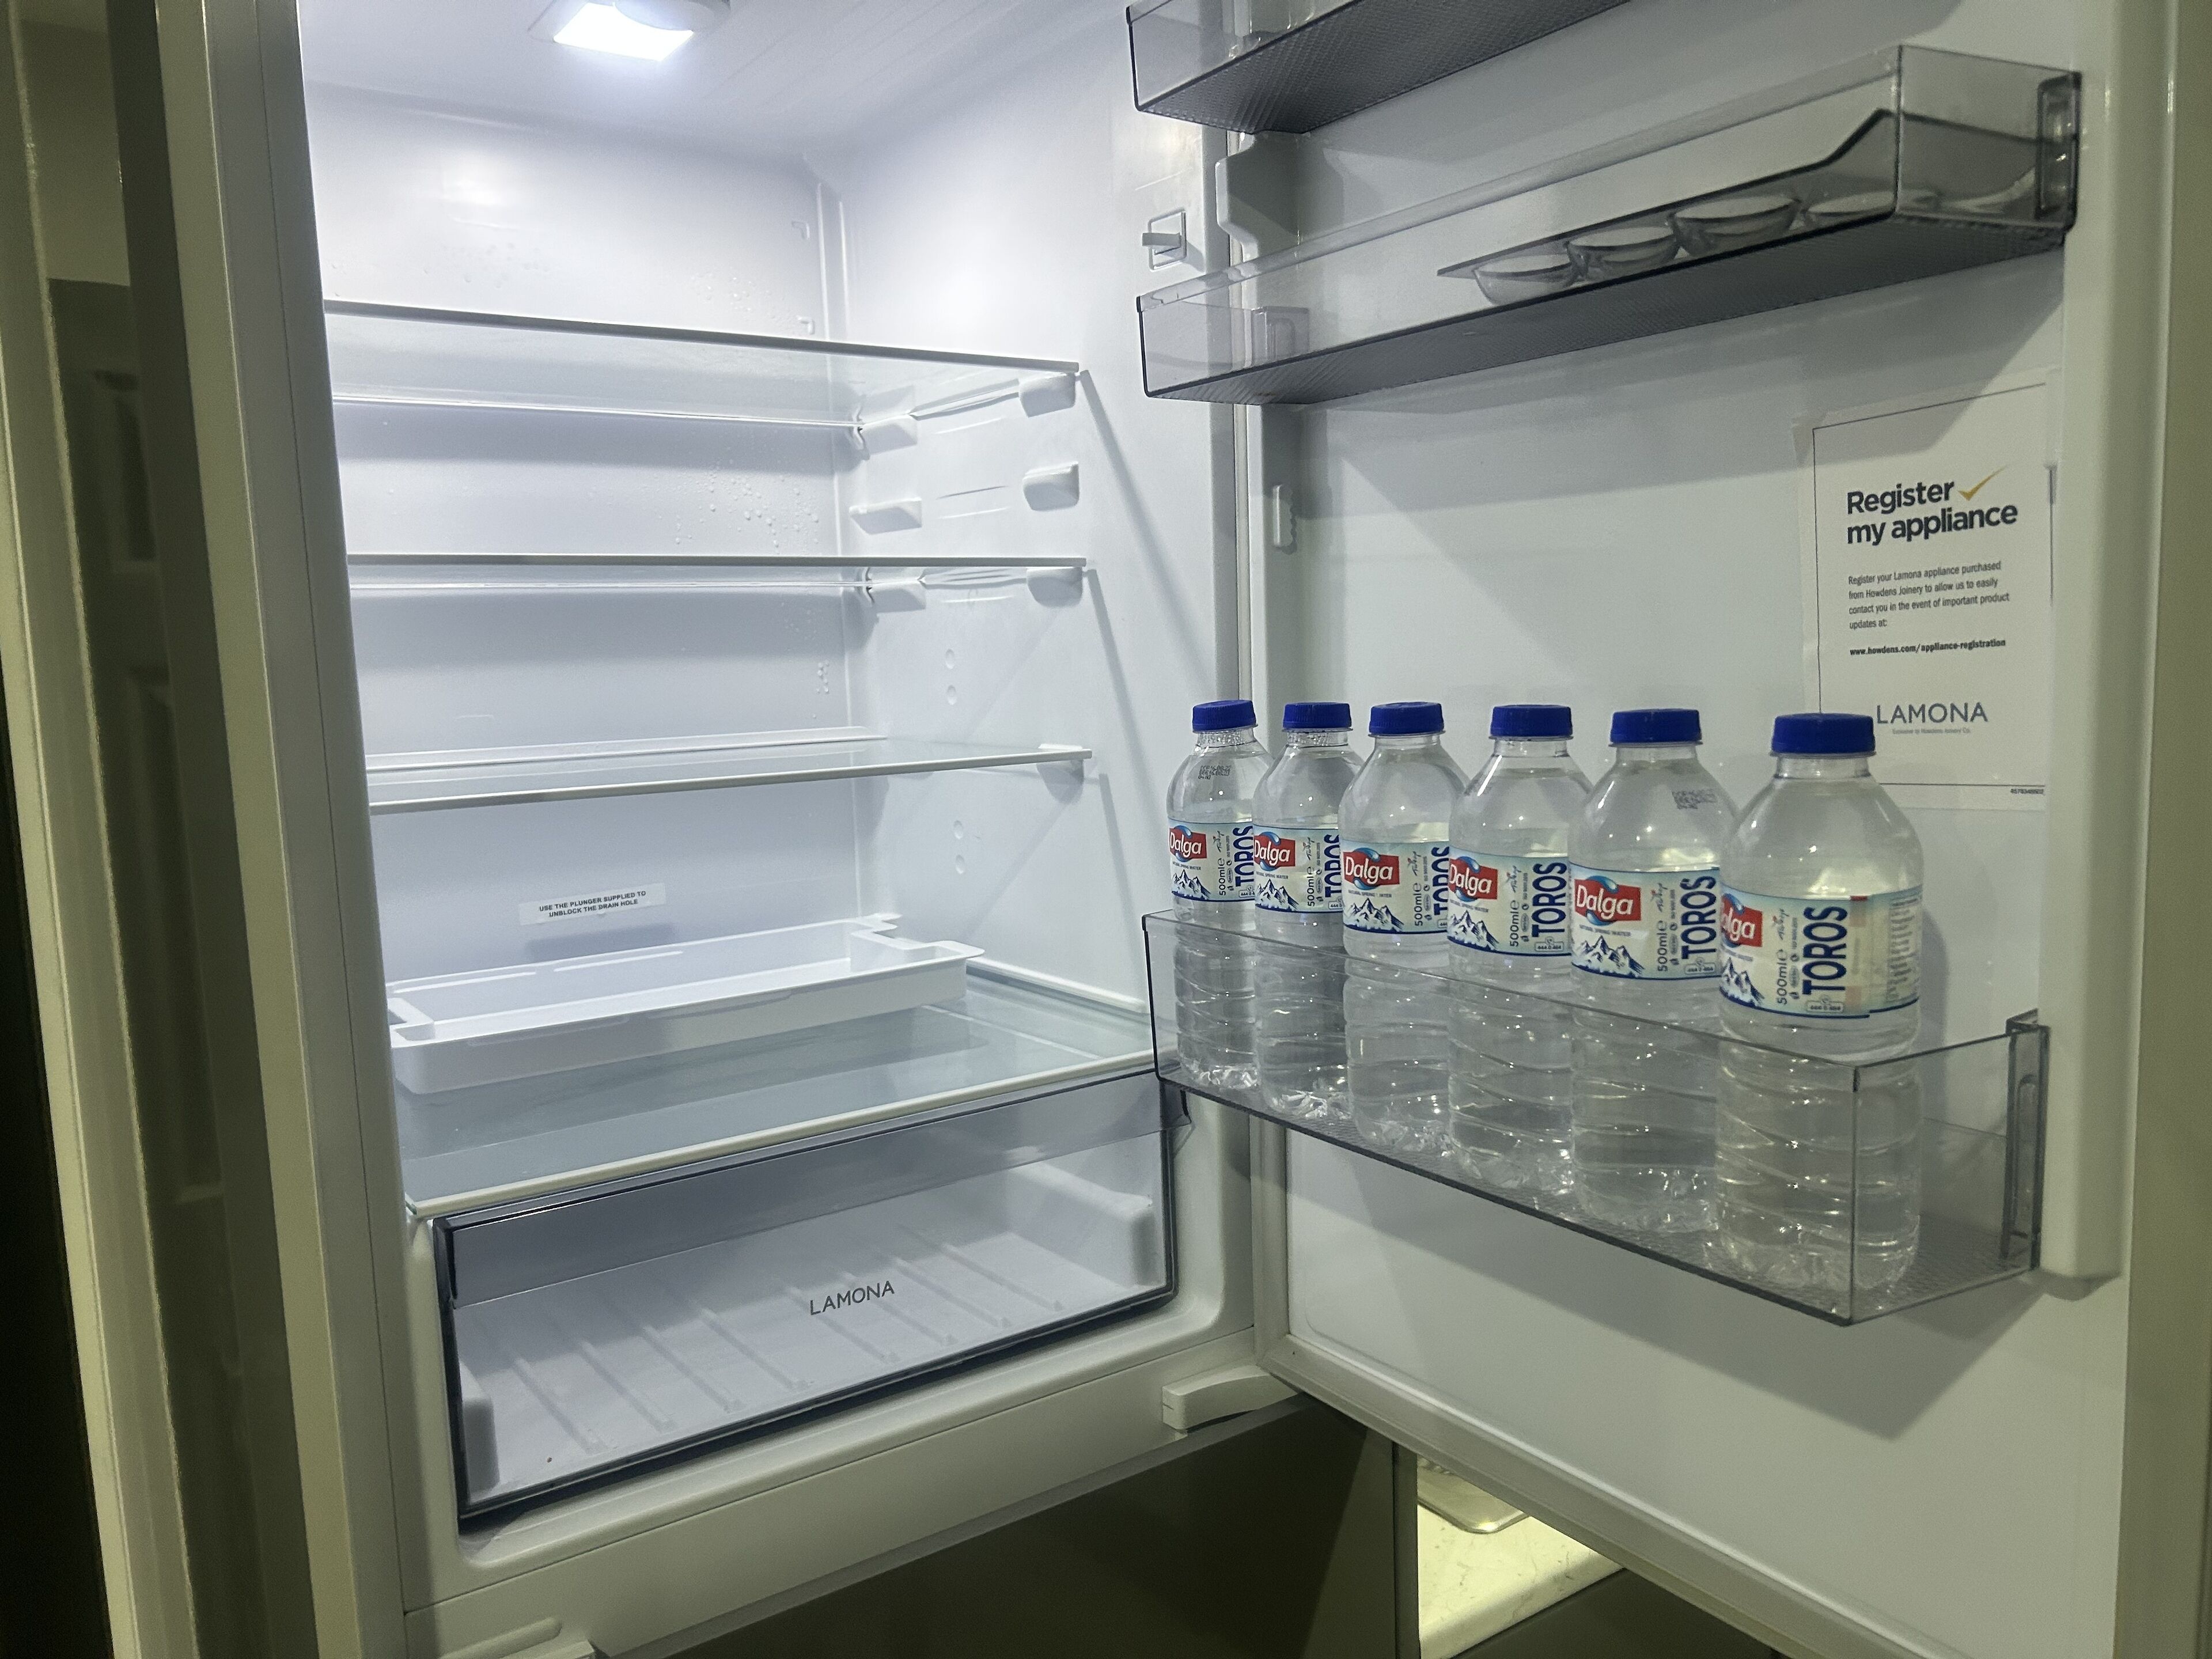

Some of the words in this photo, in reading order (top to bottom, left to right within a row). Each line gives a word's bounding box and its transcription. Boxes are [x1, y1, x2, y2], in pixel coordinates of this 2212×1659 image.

[1847, 479, 1955, 514] Register
[1847, 520, 1885, 546] my
[1891, 505, 2018, 542] appliance
[1849, 575, 1875, 586] Register
[1877, 573, 1892, 584] your
[1894, 571, 1922, 581] Lamona
[1924, 566, 1960, 578] appliance
[1962, 561, 2001, 575] purchased
[1849, 590, 1863, 599] from
[1866, 588, 1896, 598] Howdens
[1899, 585, 1923, 596] Joinery
[1934, 582, 1953, 592] allow
[1966, 581, 1974, 589] to
[1976, 577, 1998, 588] easily
[1849, 605, 1873, 615] contact
[1876, 605, 1888, 614] you
[1890, 603, 1896, 611] in
[1898, 601, 1910, 610] the
[1912, 600, 1931, 609] event
[1933, 598, 1941, 608] of
[1942, 596, 1978, 608] important
[1980, 593, 2009, 605] product
[1849, 620, 1876, 630] updates
[1850, 638, 2006, 655] www.howdens.com/appliance-registration
[1877, 702, 1988, 724] LAMONA
[1170, 832, 1202, 857] Dalga
[1233, 825, 1254, 887] TOROS
[1255, 840, 1290, 866] Dalga
[1346, 857, 1393, 884] Dalga
[1449, 864, 1492, 896] Dalga
[549, 908, 582, 917] UNBLOCK
[570, 897, 602, 907] PLUNGER
[604, 892, 635, 902] SUPPLIED
[1532, 862, 1567, 937] TOROS
[1576, 884, 1633, 919] Dalga
[1680, 876, 1717, 959] TOROS
[1802, 906, 1848, 995] TOROS
[810, 1281, 895, 1315] LAMONA
